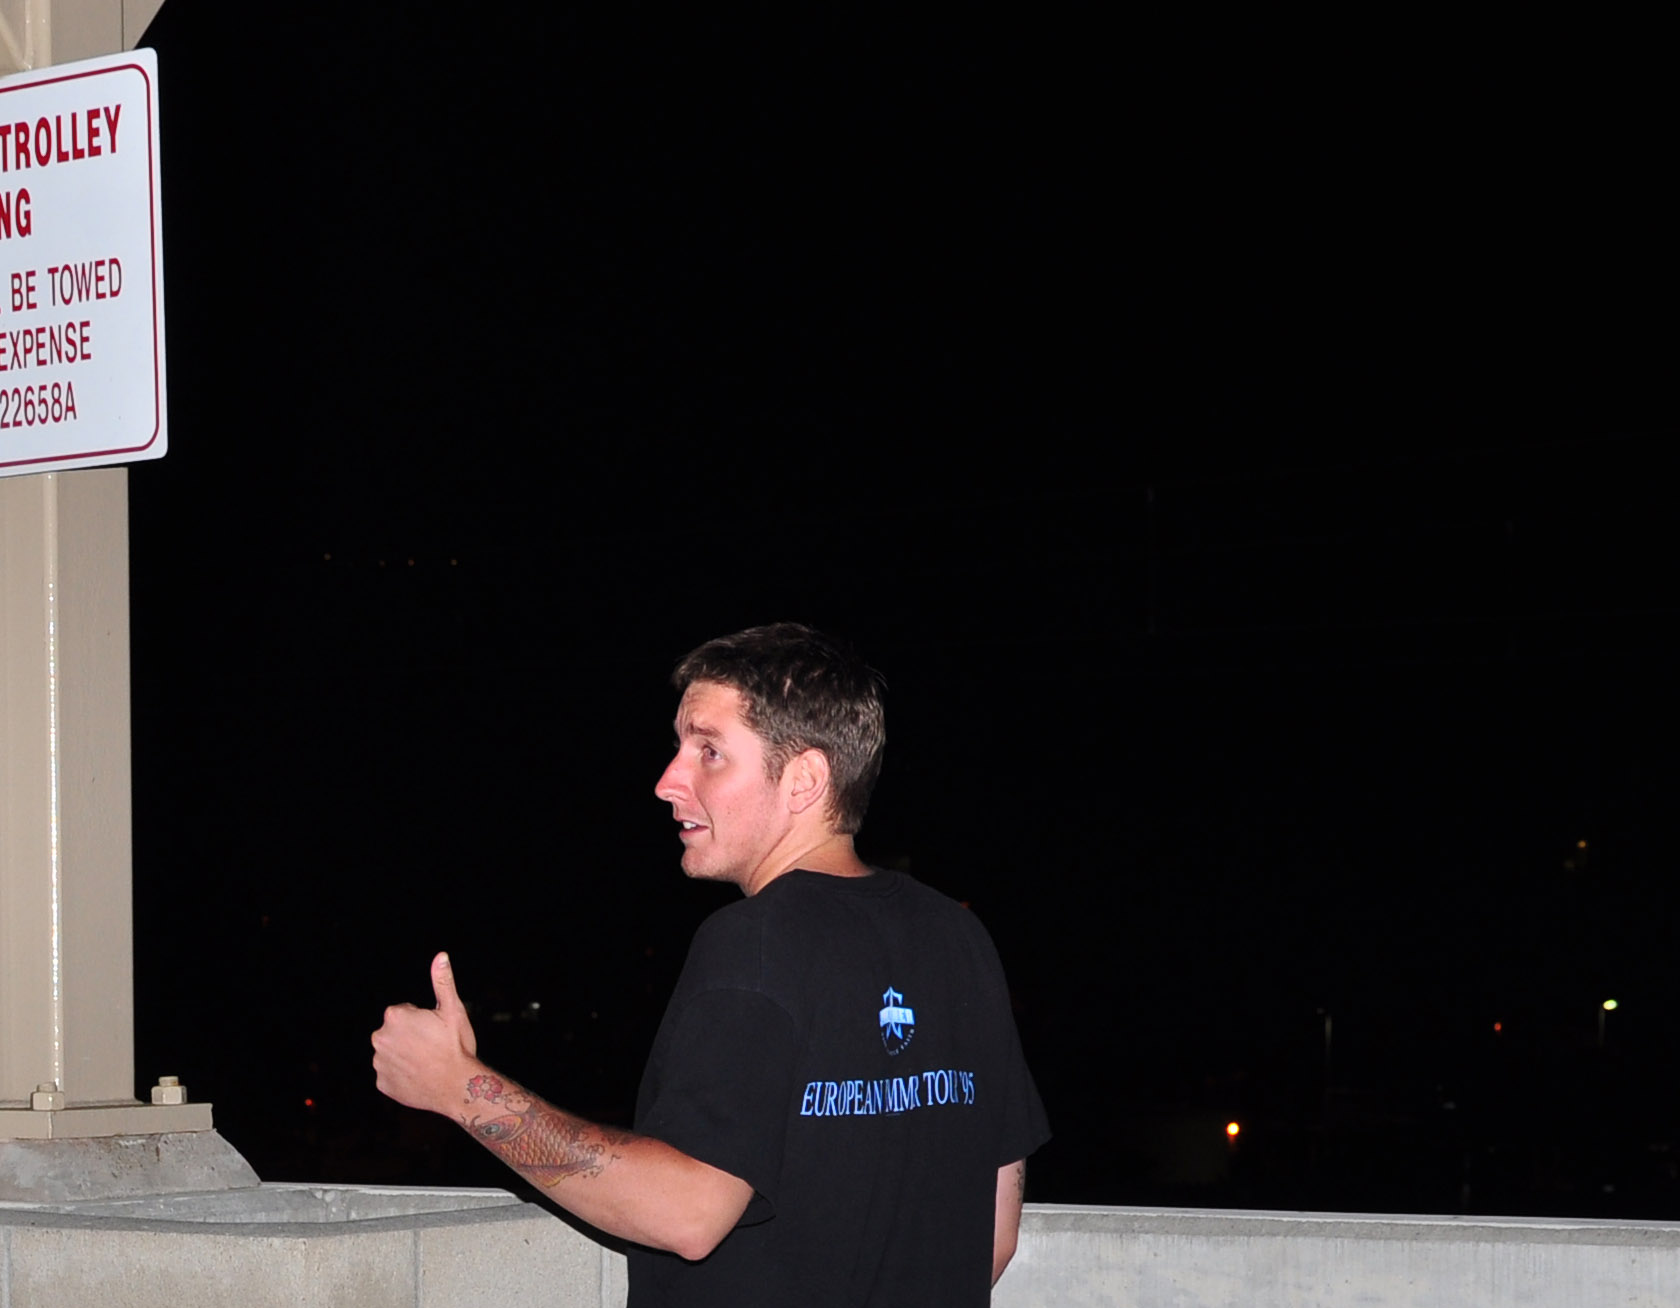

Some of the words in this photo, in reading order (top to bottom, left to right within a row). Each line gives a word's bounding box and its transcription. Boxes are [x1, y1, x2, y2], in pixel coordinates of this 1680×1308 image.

[11, 270, 38, 313] BE
[48, 258, 122, 307] TOWED
[0, 381, 77, 430] 22658A
[800, 1080, 883, 1116] EUROPEAN
